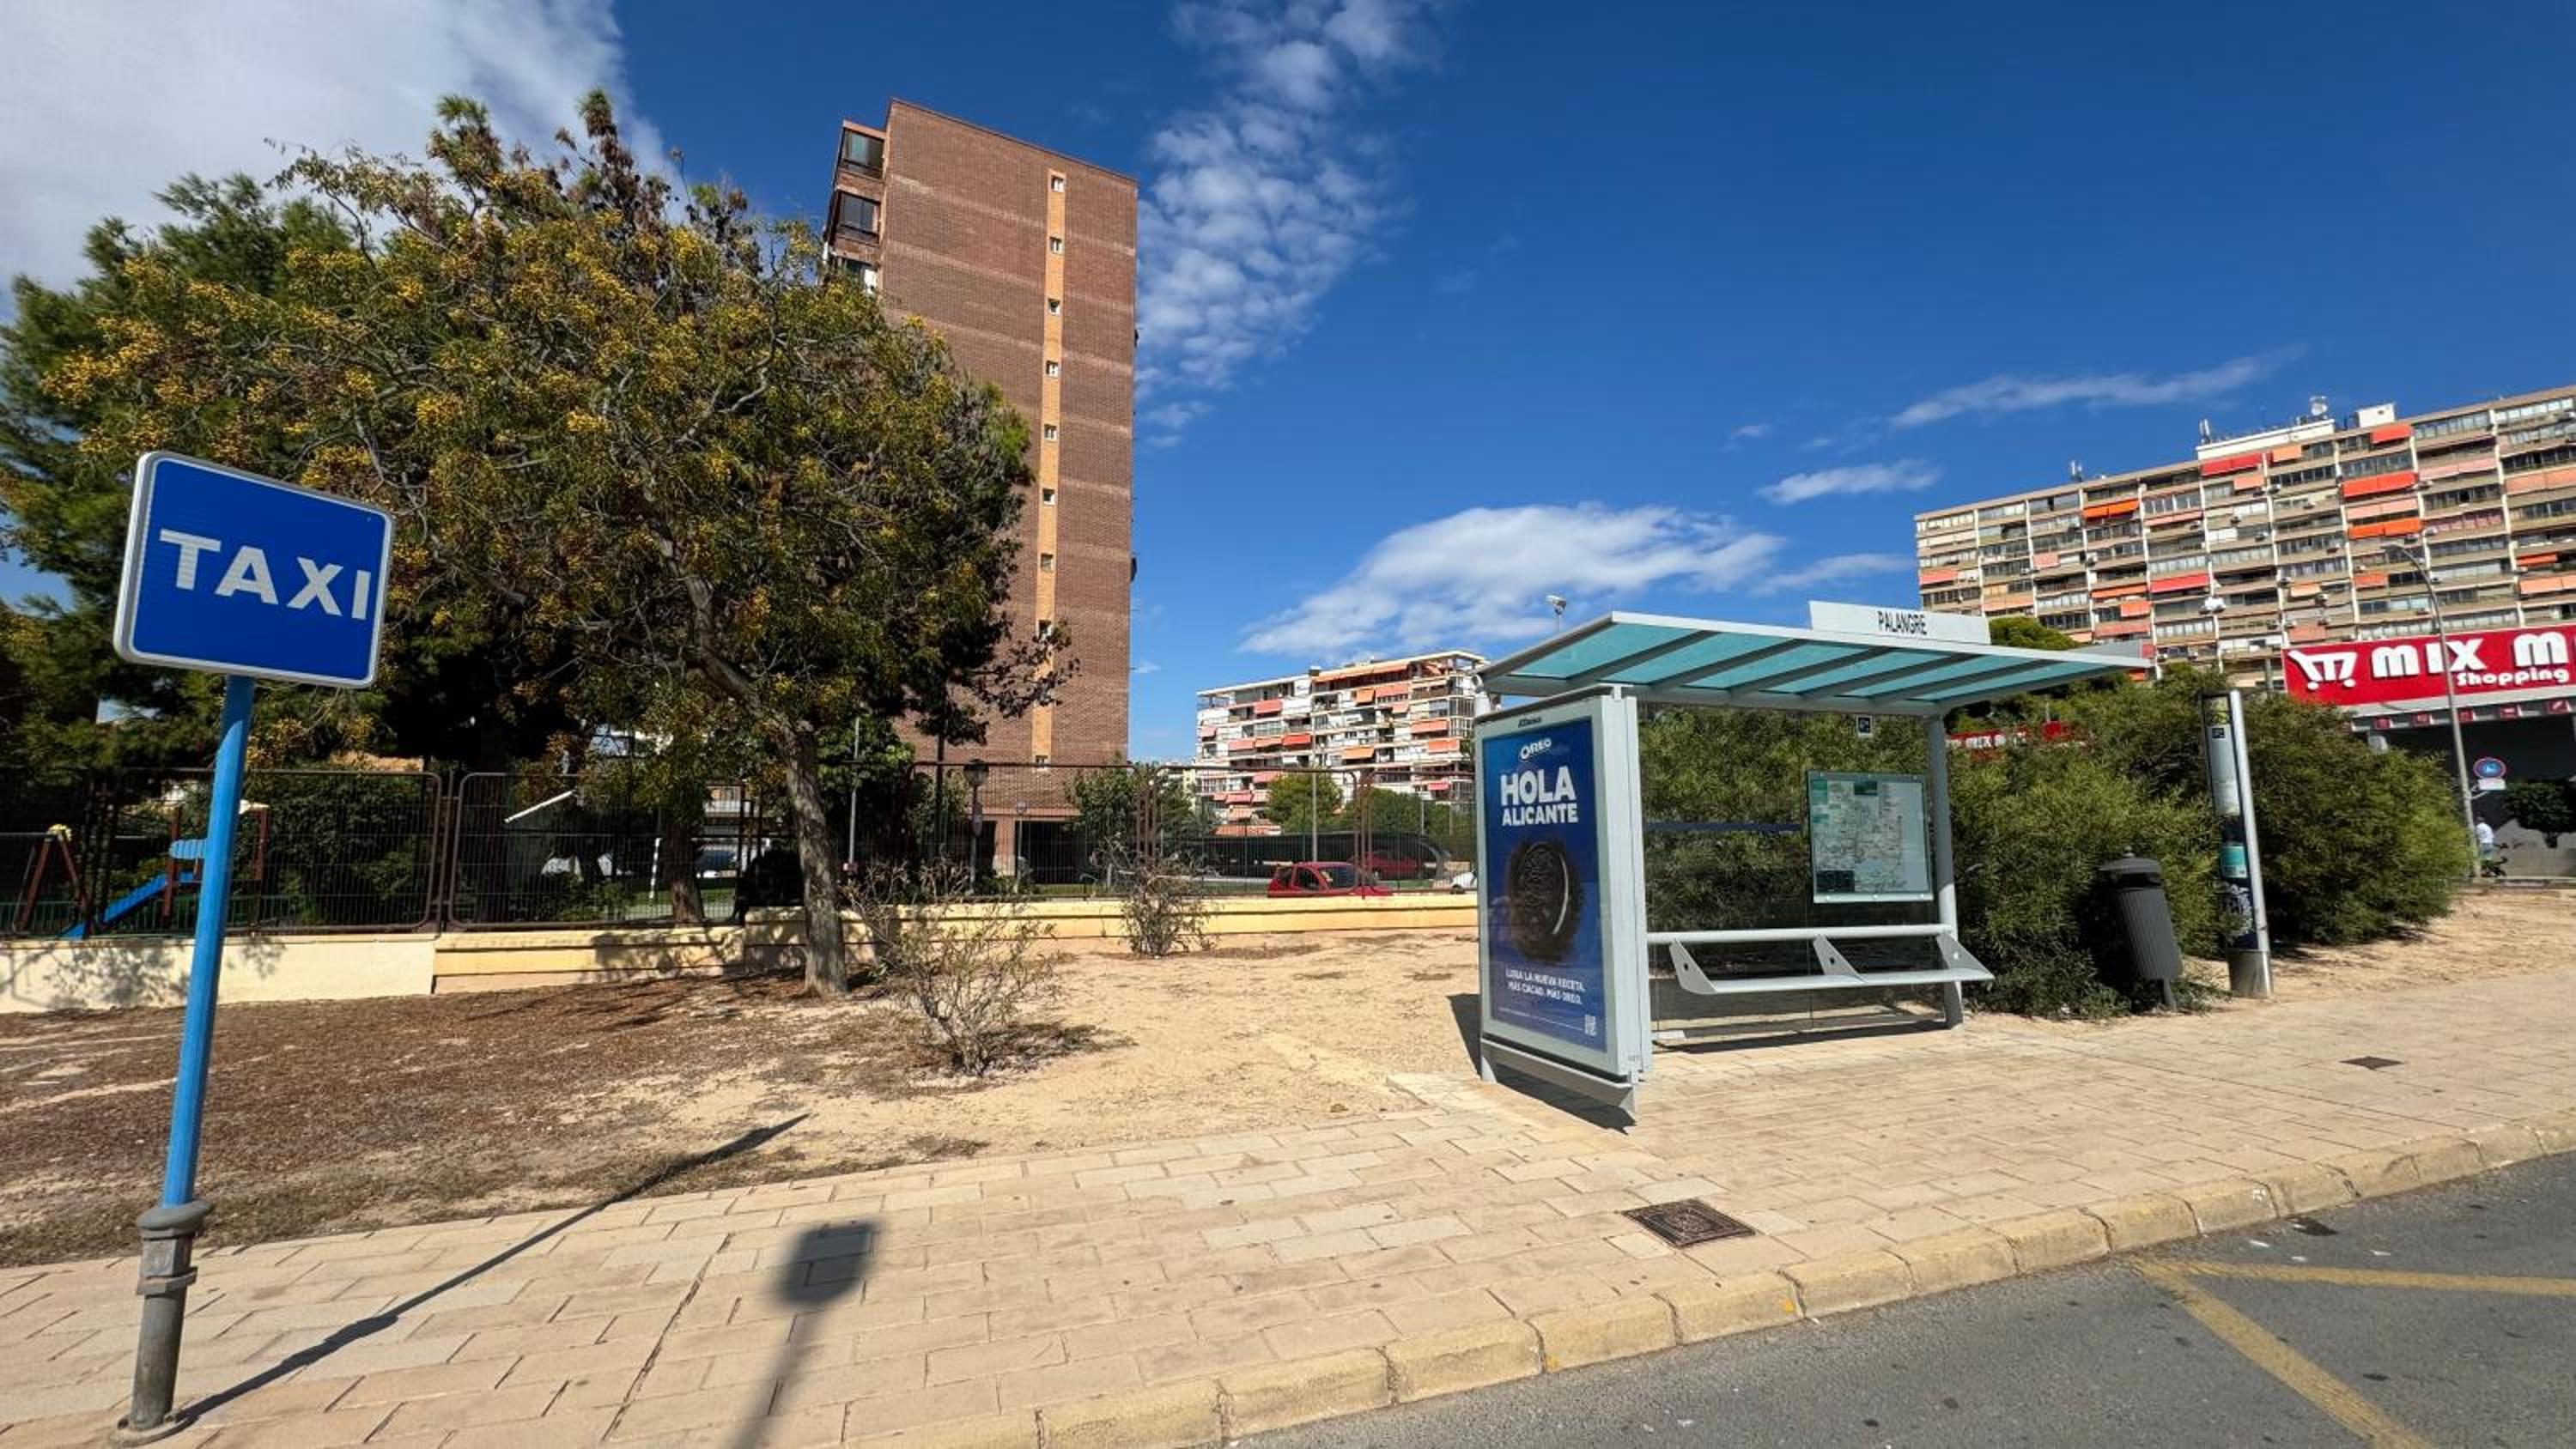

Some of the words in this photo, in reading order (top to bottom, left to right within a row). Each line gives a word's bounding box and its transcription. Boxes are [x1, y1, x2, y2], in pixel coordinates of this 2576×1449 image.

[159, 528, 372, 621] TAXI
[1878, 610, 1927, 635] PALANGRE
[2371, 638, 2488, 678] MIX
[2456, 667, 2570, 686] Shopping
[1521, 737, 1552, 760] OREO
[1500, 765, 1577, 806] HOLA
[1501, 803, 1579, 827] ALICANTE
